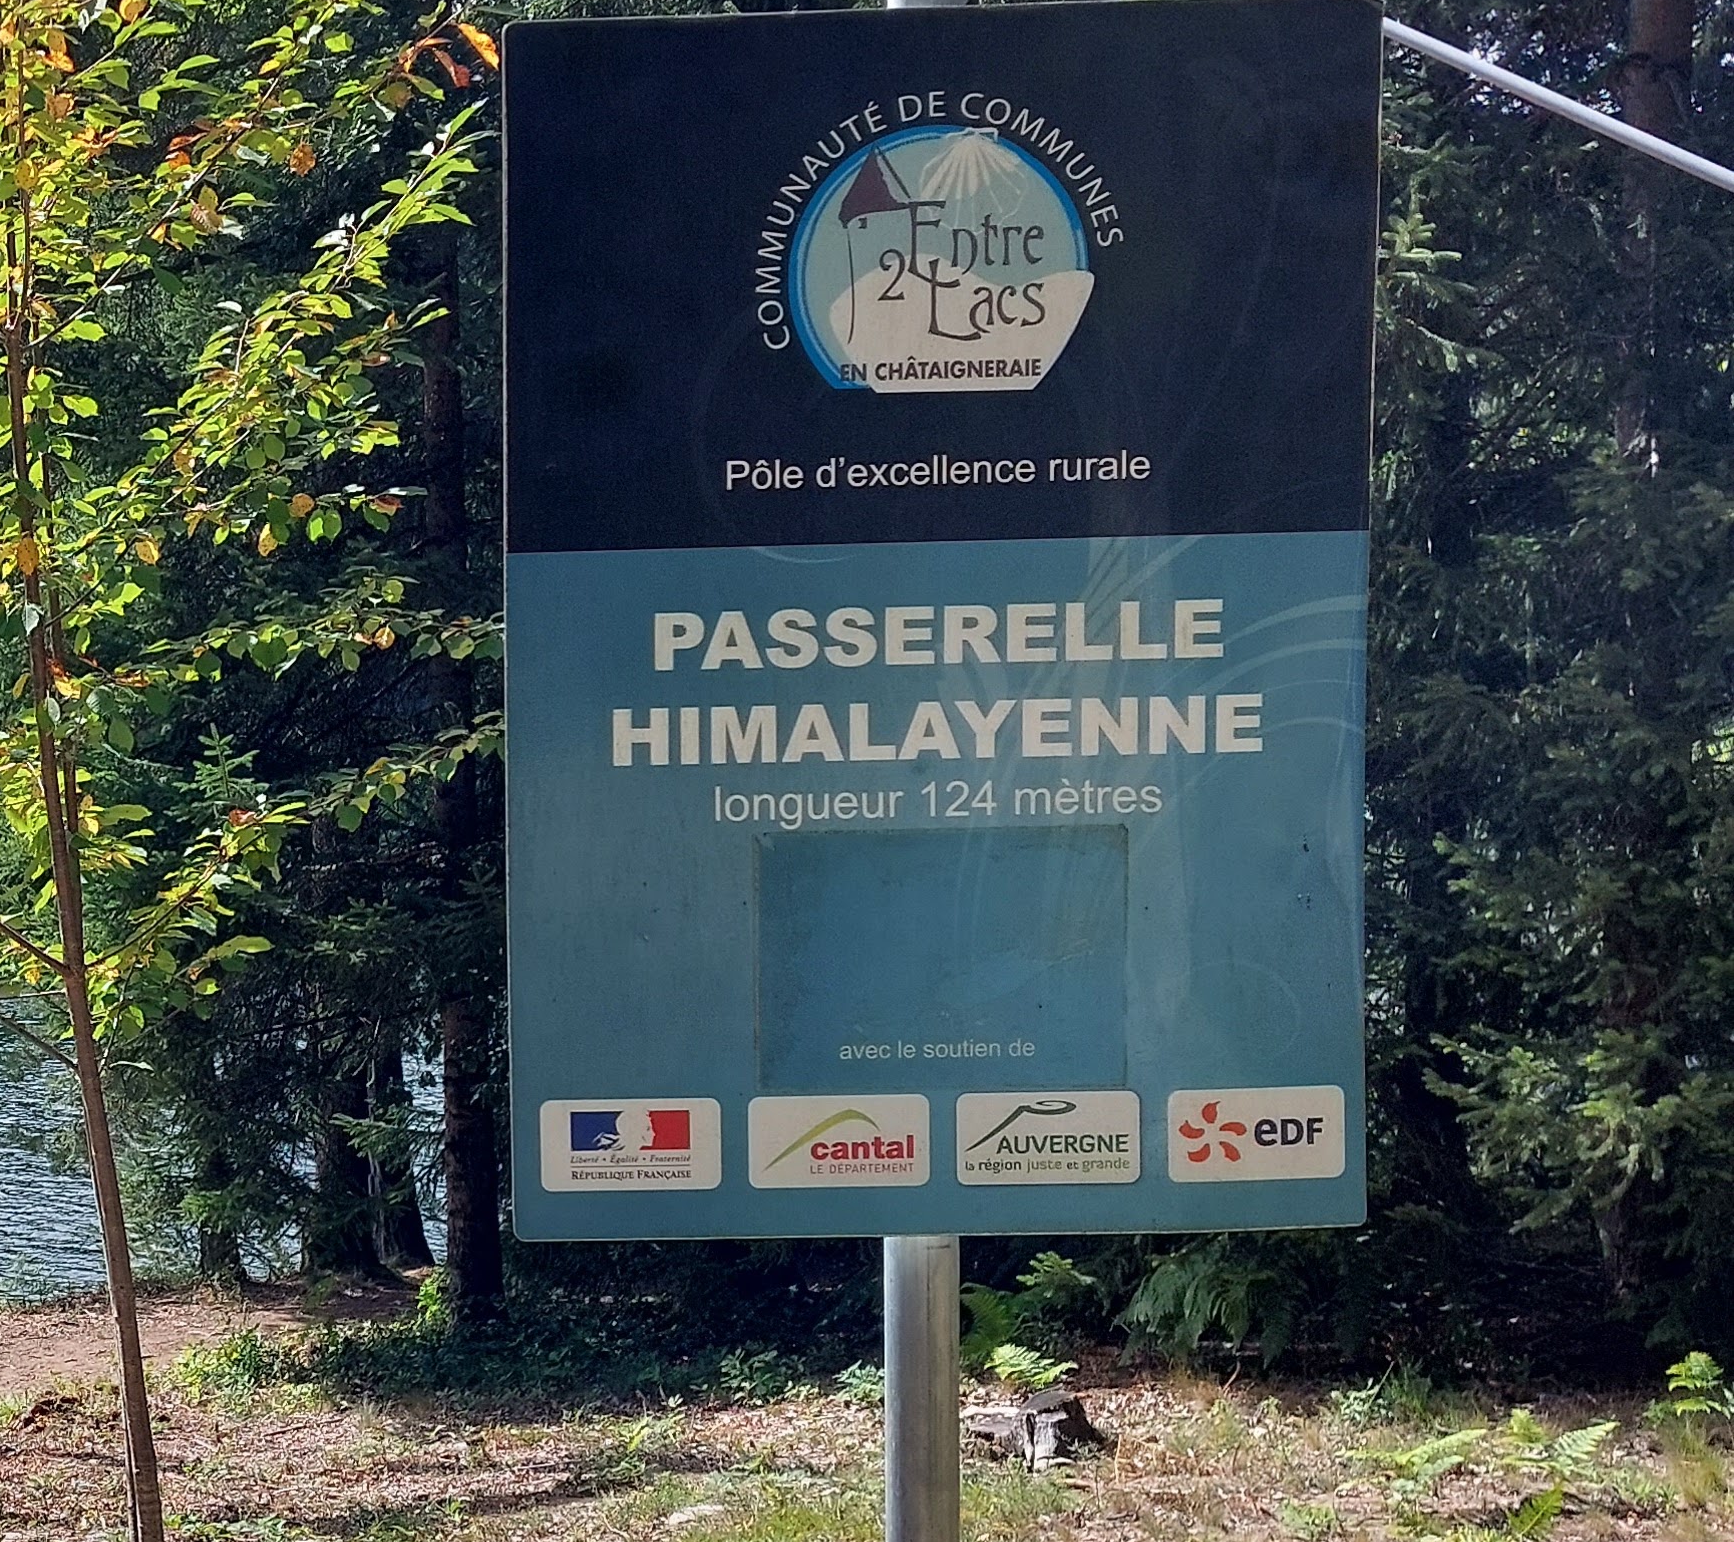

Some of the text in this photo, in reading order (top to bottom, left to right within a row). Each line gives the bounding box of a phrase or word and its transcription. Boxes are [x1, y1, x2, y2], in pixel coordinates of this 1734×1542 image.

[754, 91, 1125, 350] COMMUNAUTÉ DE COMMUNES
[907, 199, 1045, 289] Entre
[877, 247, 1047, 342] 2 Lacs
[840, 355, 1042, 382] EN CHÂTAIGNERAIE
[724, 459, 805, 491] Pôle
[1048, 449, 1152, 482] rurale
[652, 598, 1226, 672] PASSERELLE
[612, 692, 1264, 767] HIMALAYENNE
[713, 776, 1163, 830] longueur 124 mètres
[838, 1038, 1036, 1060] avec le soutien de
[569, 1155, 599, 1164] Liberté
[649, 1154, 692, 1163] Fraternité
[810, 1134, 915, 1161] cantal
[995, 1133, 1130, 1155] AUVERGNE
[810, 1164, 824, 1175] LE
[965, 1156, 1131, 1174] la région juste et grande
